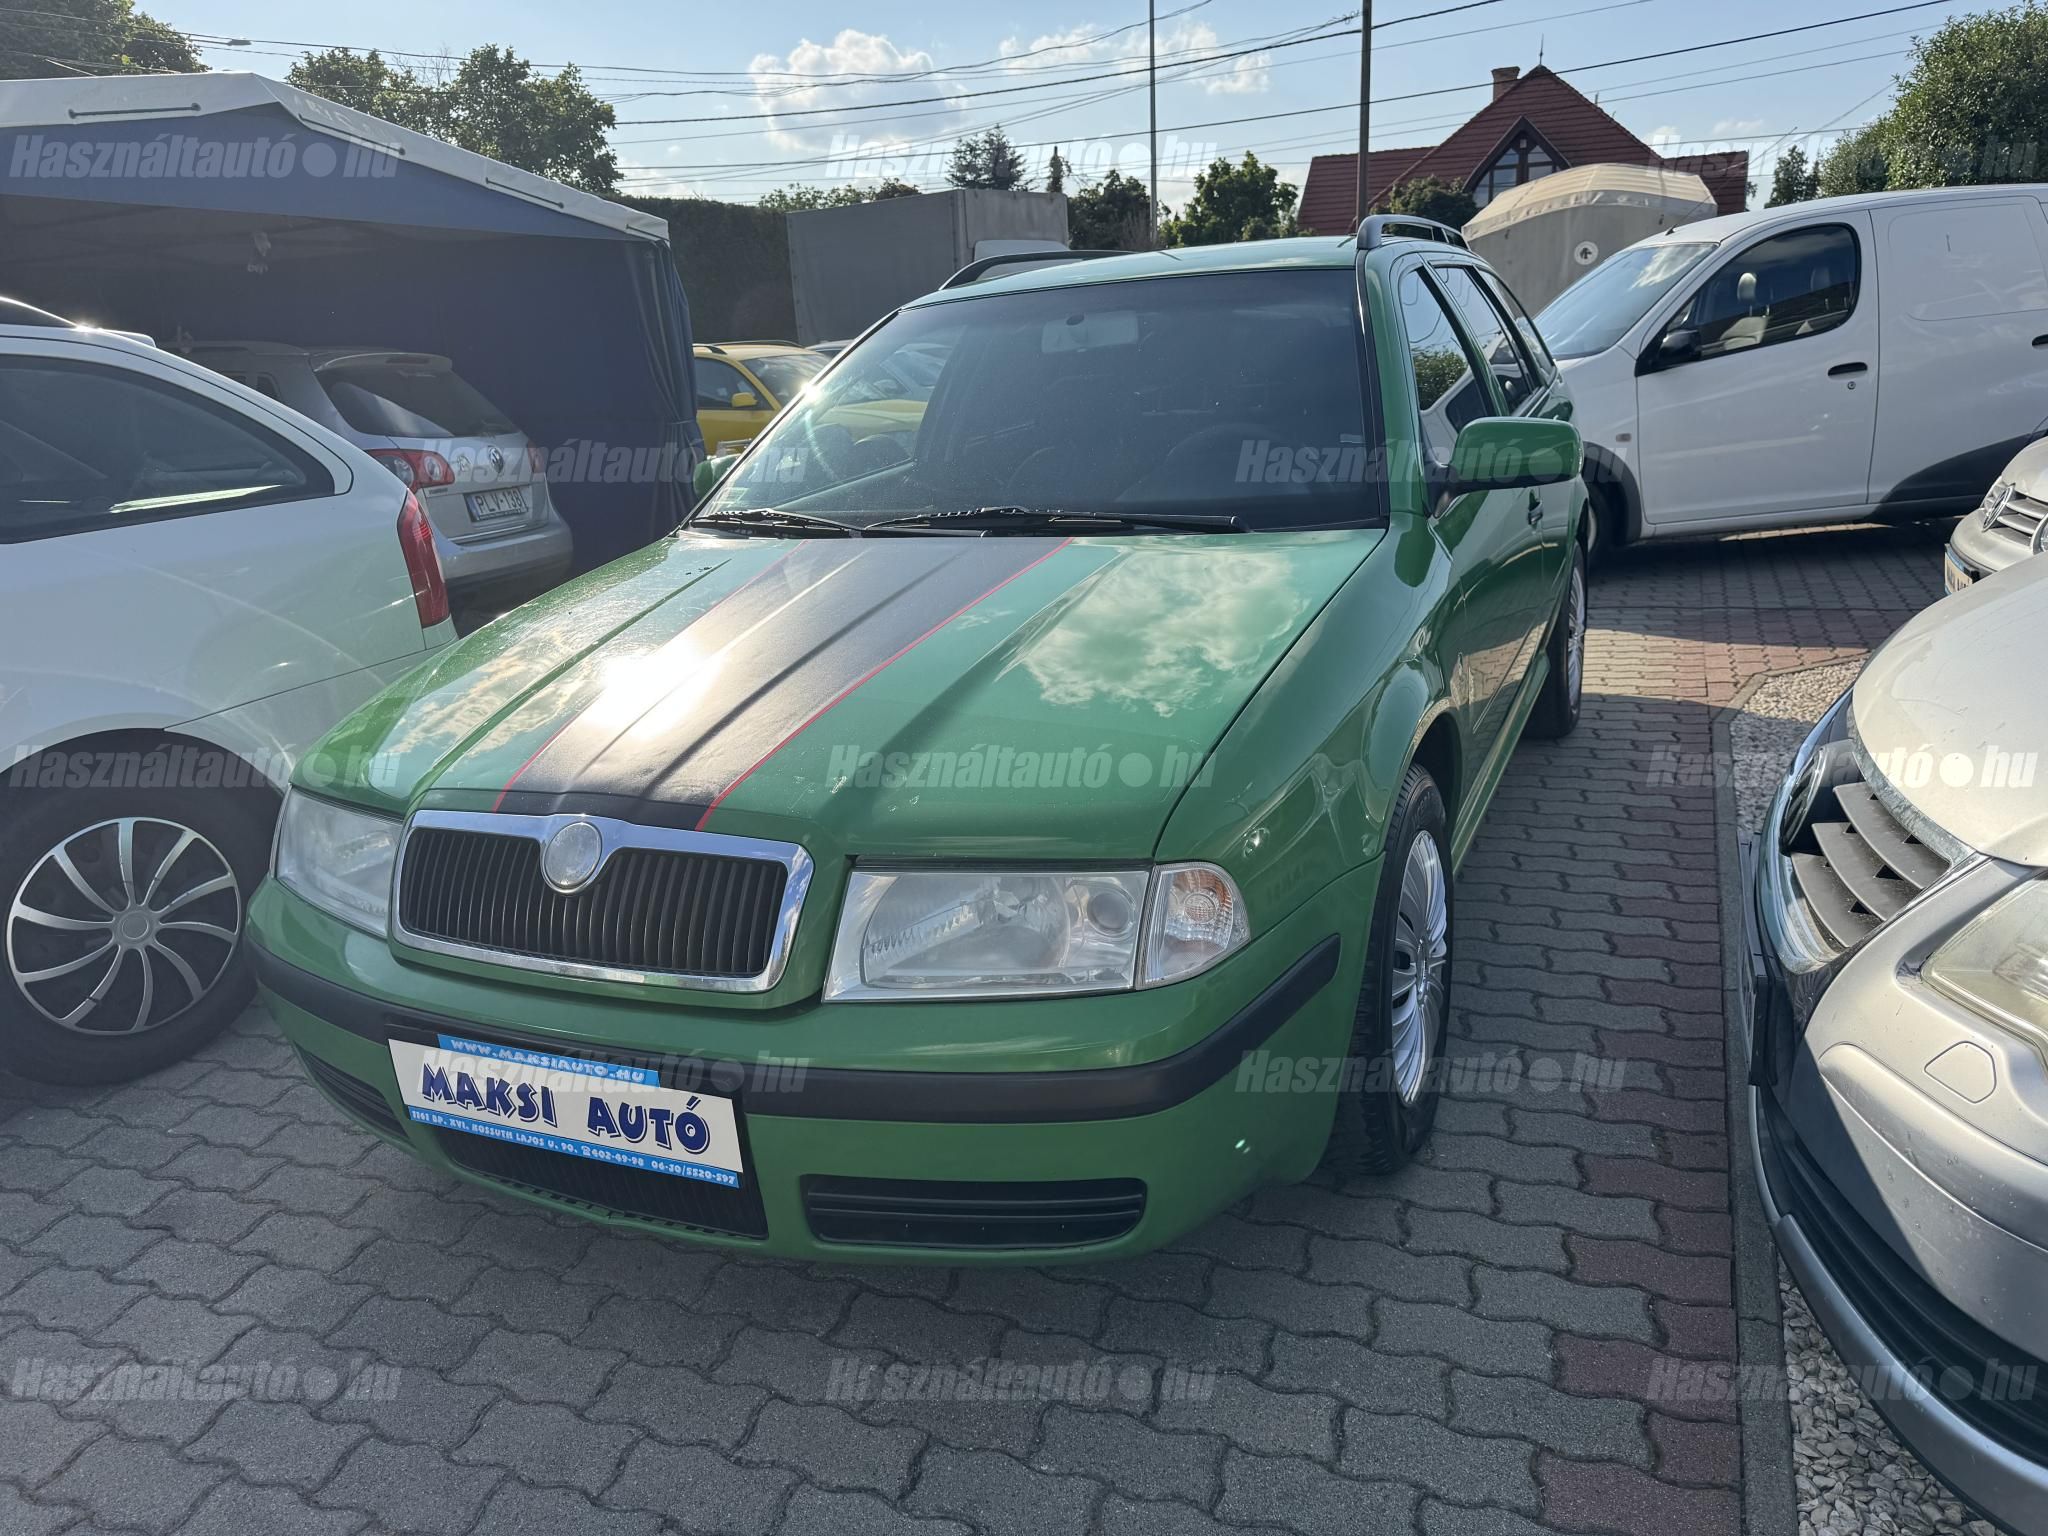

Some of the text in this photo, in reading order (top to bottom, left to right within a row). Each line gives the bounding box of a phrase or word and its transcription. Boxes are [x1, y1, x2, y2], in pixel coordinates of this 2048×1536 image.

[475, 488, 523, 514] PLV-138
[422, 1062, 711, 1155] MAKSI AUTÓ
[471, 1123, 513, 1140] KOSSUTH
[515, 1132, 545, 1147] LAJOS
